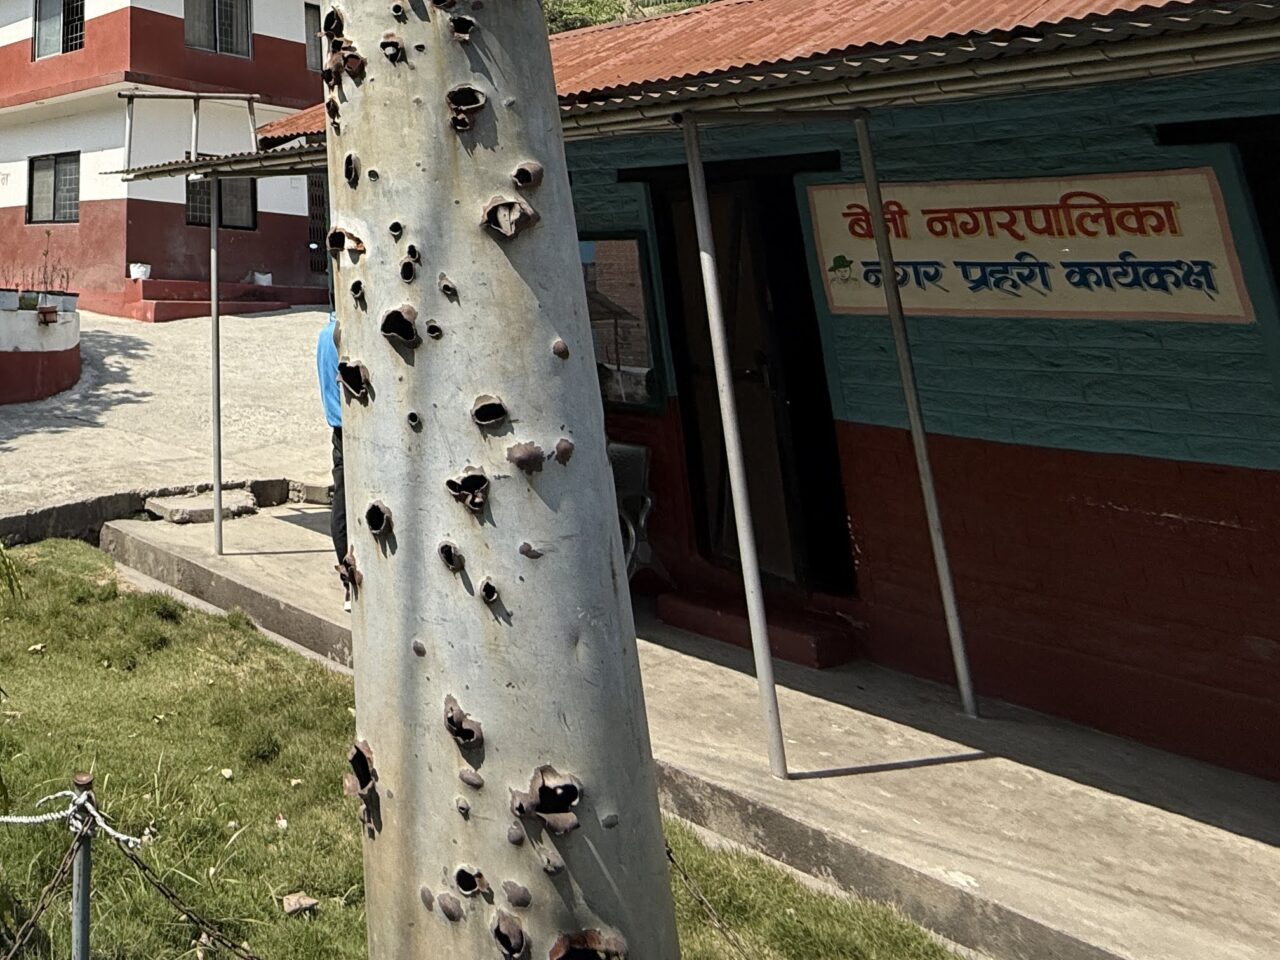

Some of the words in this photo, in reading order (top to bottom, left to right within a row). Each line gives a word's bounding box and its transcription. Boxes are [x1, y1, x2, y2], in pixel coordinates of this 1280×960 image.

[921, 191, 1181, 241] नगरपालिका
[953, 251, 1053, 297] प्रहरी
[1060, 251, 1219, 302] कार्यकक्ष
